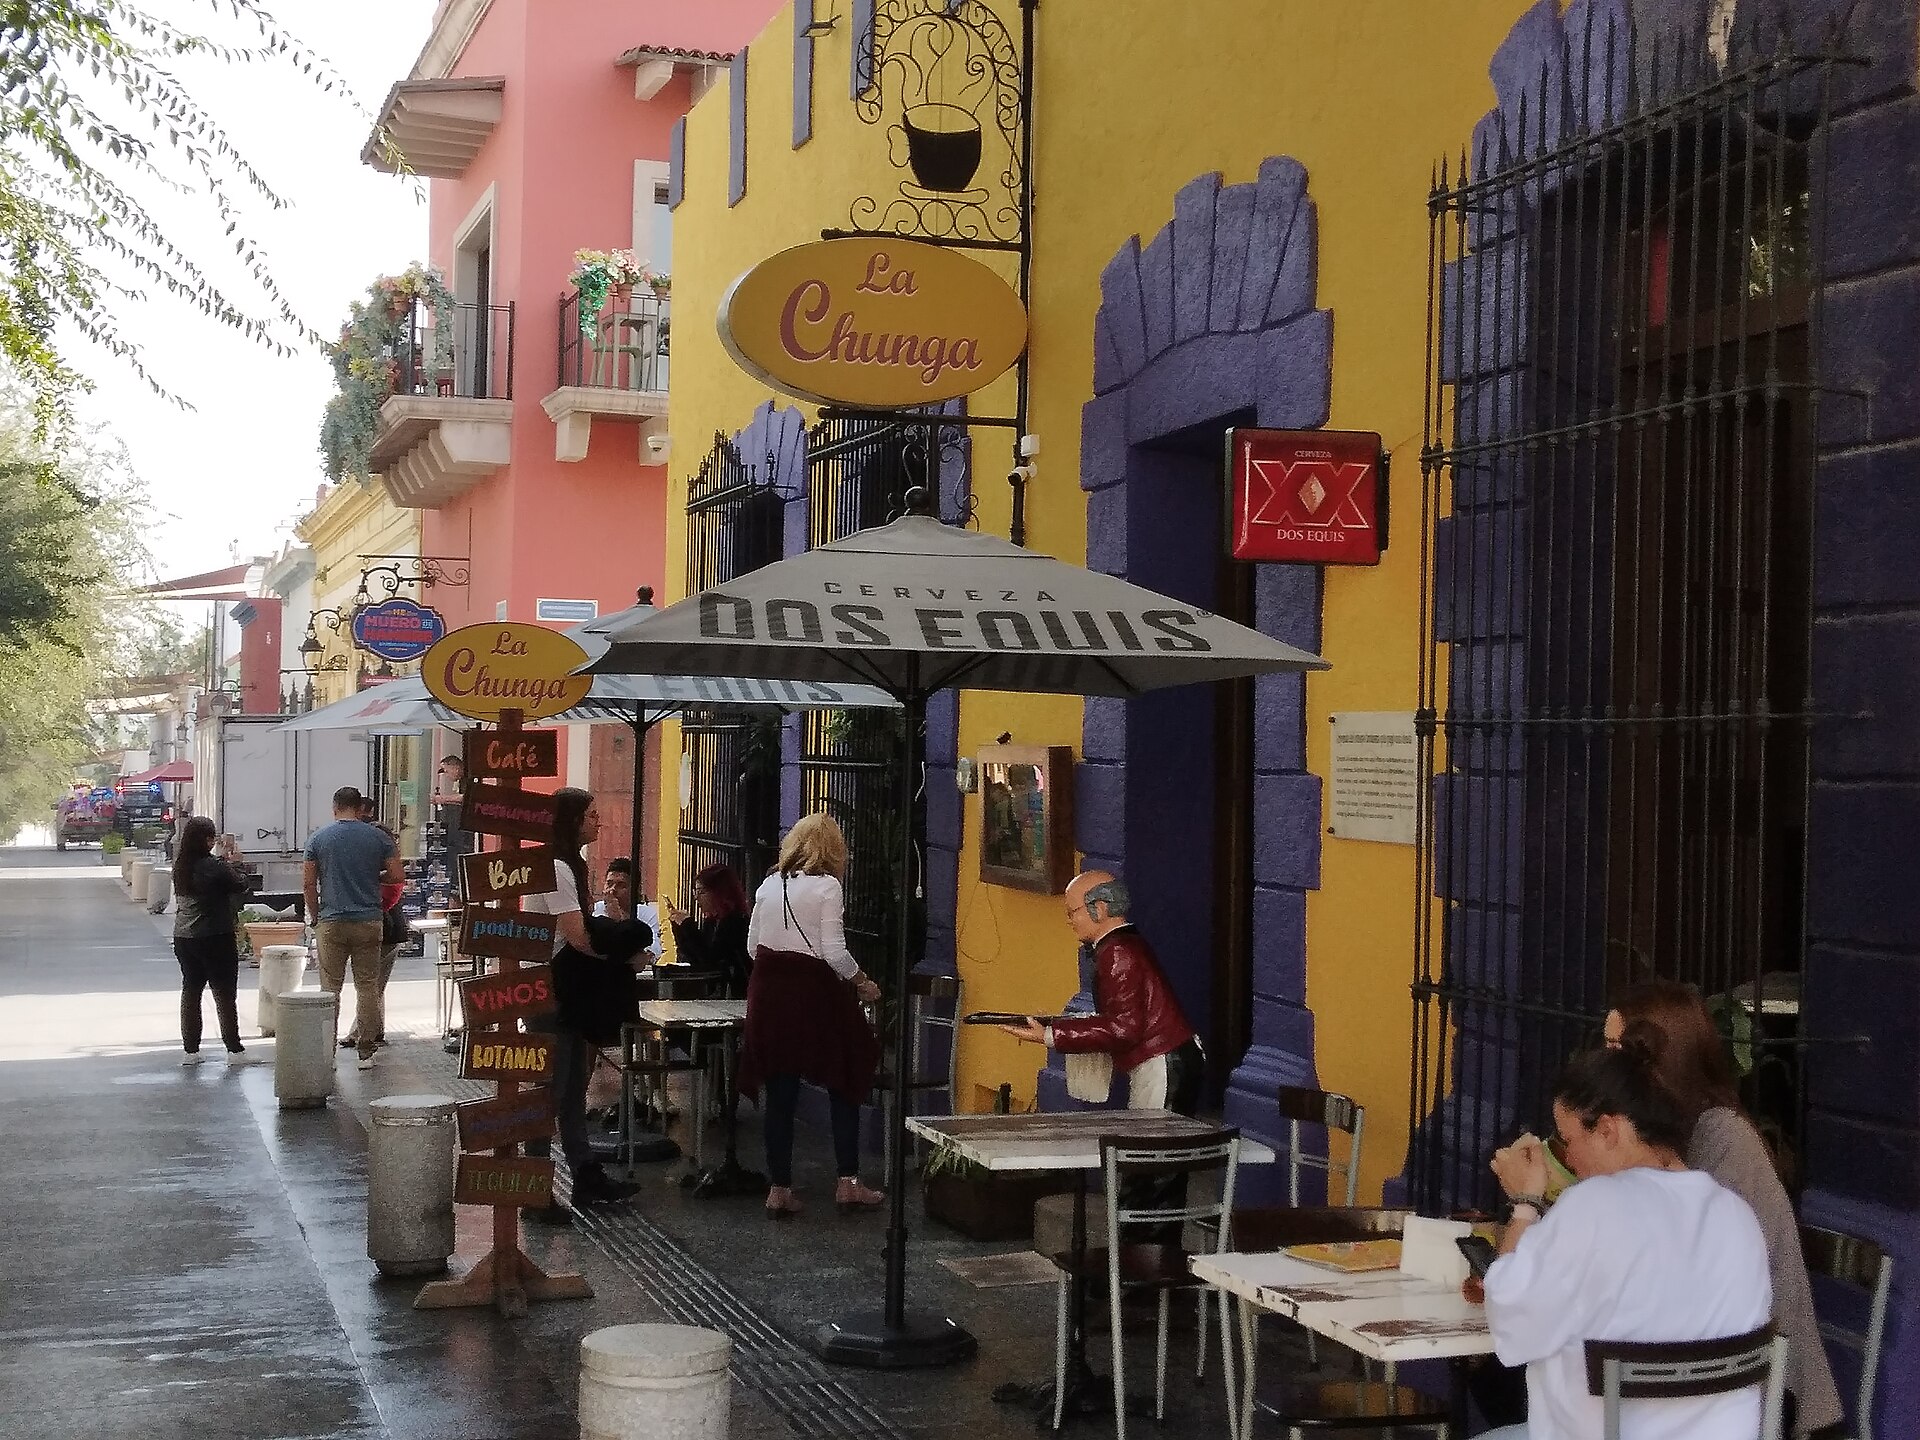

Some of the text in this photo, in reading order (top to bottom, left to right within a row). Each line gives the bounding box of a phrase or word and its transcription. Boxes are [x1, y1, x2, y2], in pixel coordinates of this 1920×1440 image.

[855, 252, 919, 296] La
[779, 279, 983, 386] Chunga
[1276, 528, 1345, 543] DOS EQUIS
[823, 581, 1056, 602] CERVEZA
[699, 592, 1213, 652] DOS EQUIS
[490, 631, 529, 656] La
[444, 647, 568, 710] Chunga
[486, 740, 539, 772] Café
[488, 859, 533, 891] Bar
[472, 919, 550, 943] postres
[472, 979, 549, 1011] VINOS
[472, 1044, 548, 1072] BOTANAS
